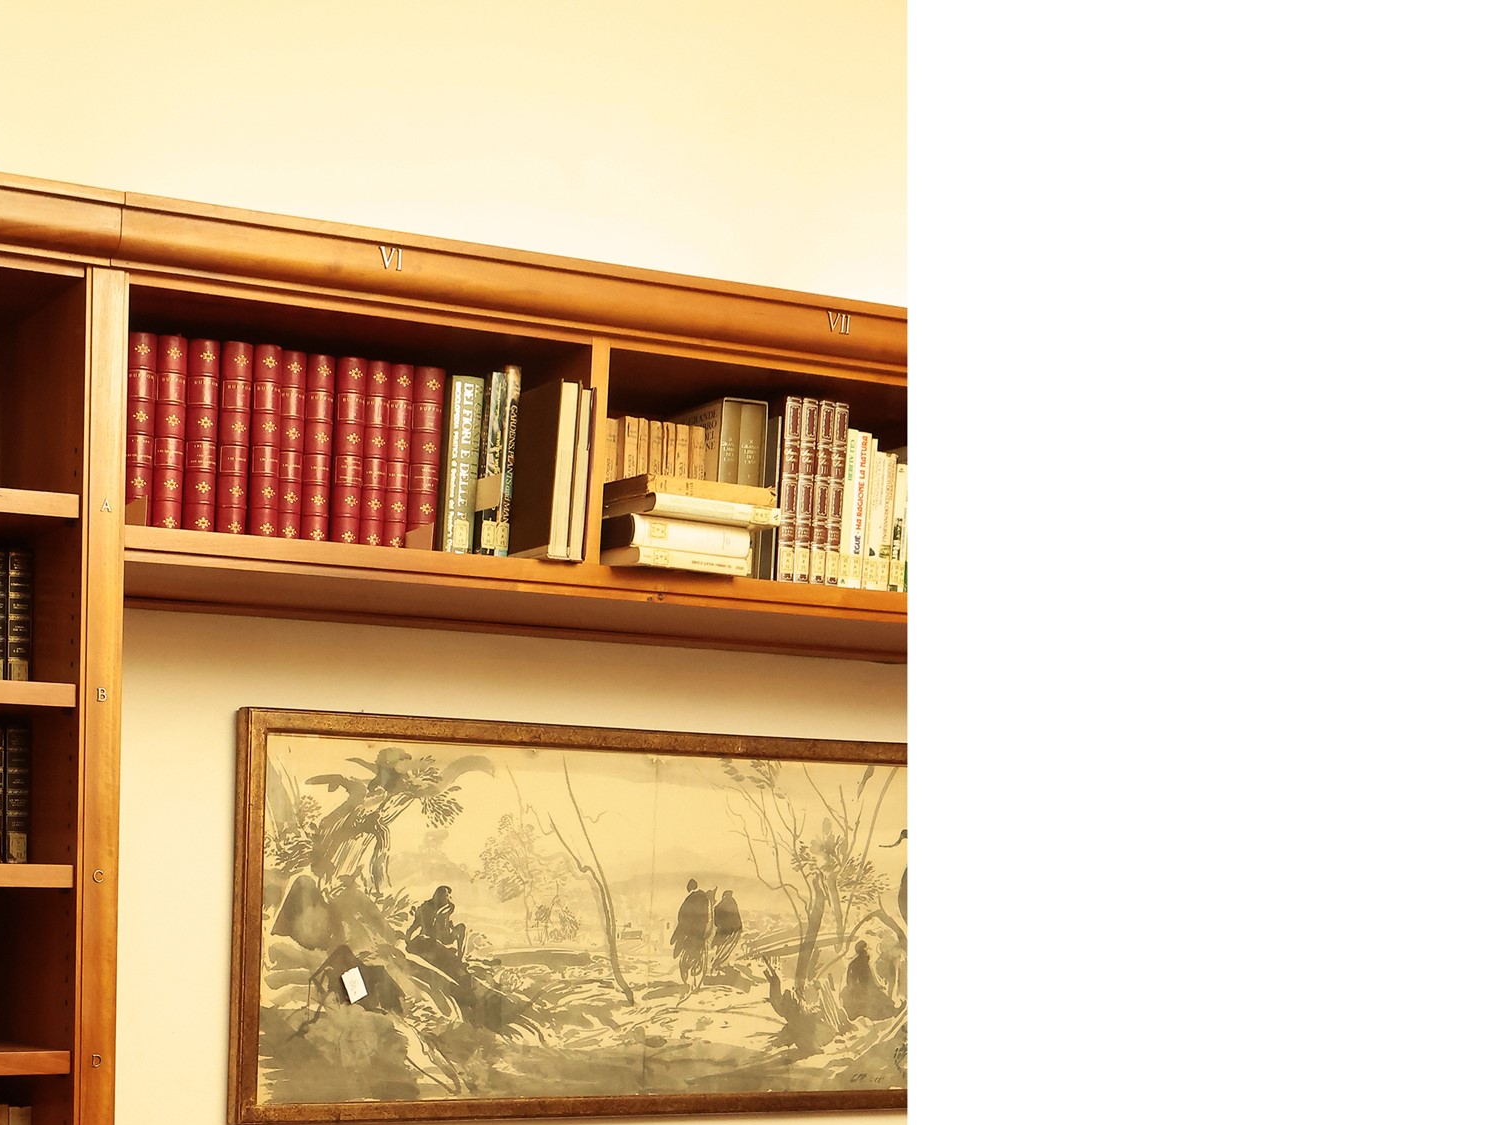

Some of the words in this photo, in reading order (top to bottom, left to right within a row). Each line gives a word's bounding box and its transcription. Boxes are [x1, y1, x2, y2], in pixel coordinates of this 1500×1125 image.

[379, 245, 402, 271] VI
[827, 310, 851, 335] VII
[463, 382, 474, 405] DEI
[461, 409, 473, 444] FIORI
[460, 449, 471, 459] E
[860, 436, 868, 468] NATURA
[859, 470, 866, 480] LA
[457, 462, 470, 508] DELLE
[100, 499, 112, 513] A
[856, 482, 865, 518] RAGIONE
[856, 519, 862, 530] HA
[97, 688, 107, 702] B
[93, 869, 104, 883] C
[92, 1054, 102, 1068] D
